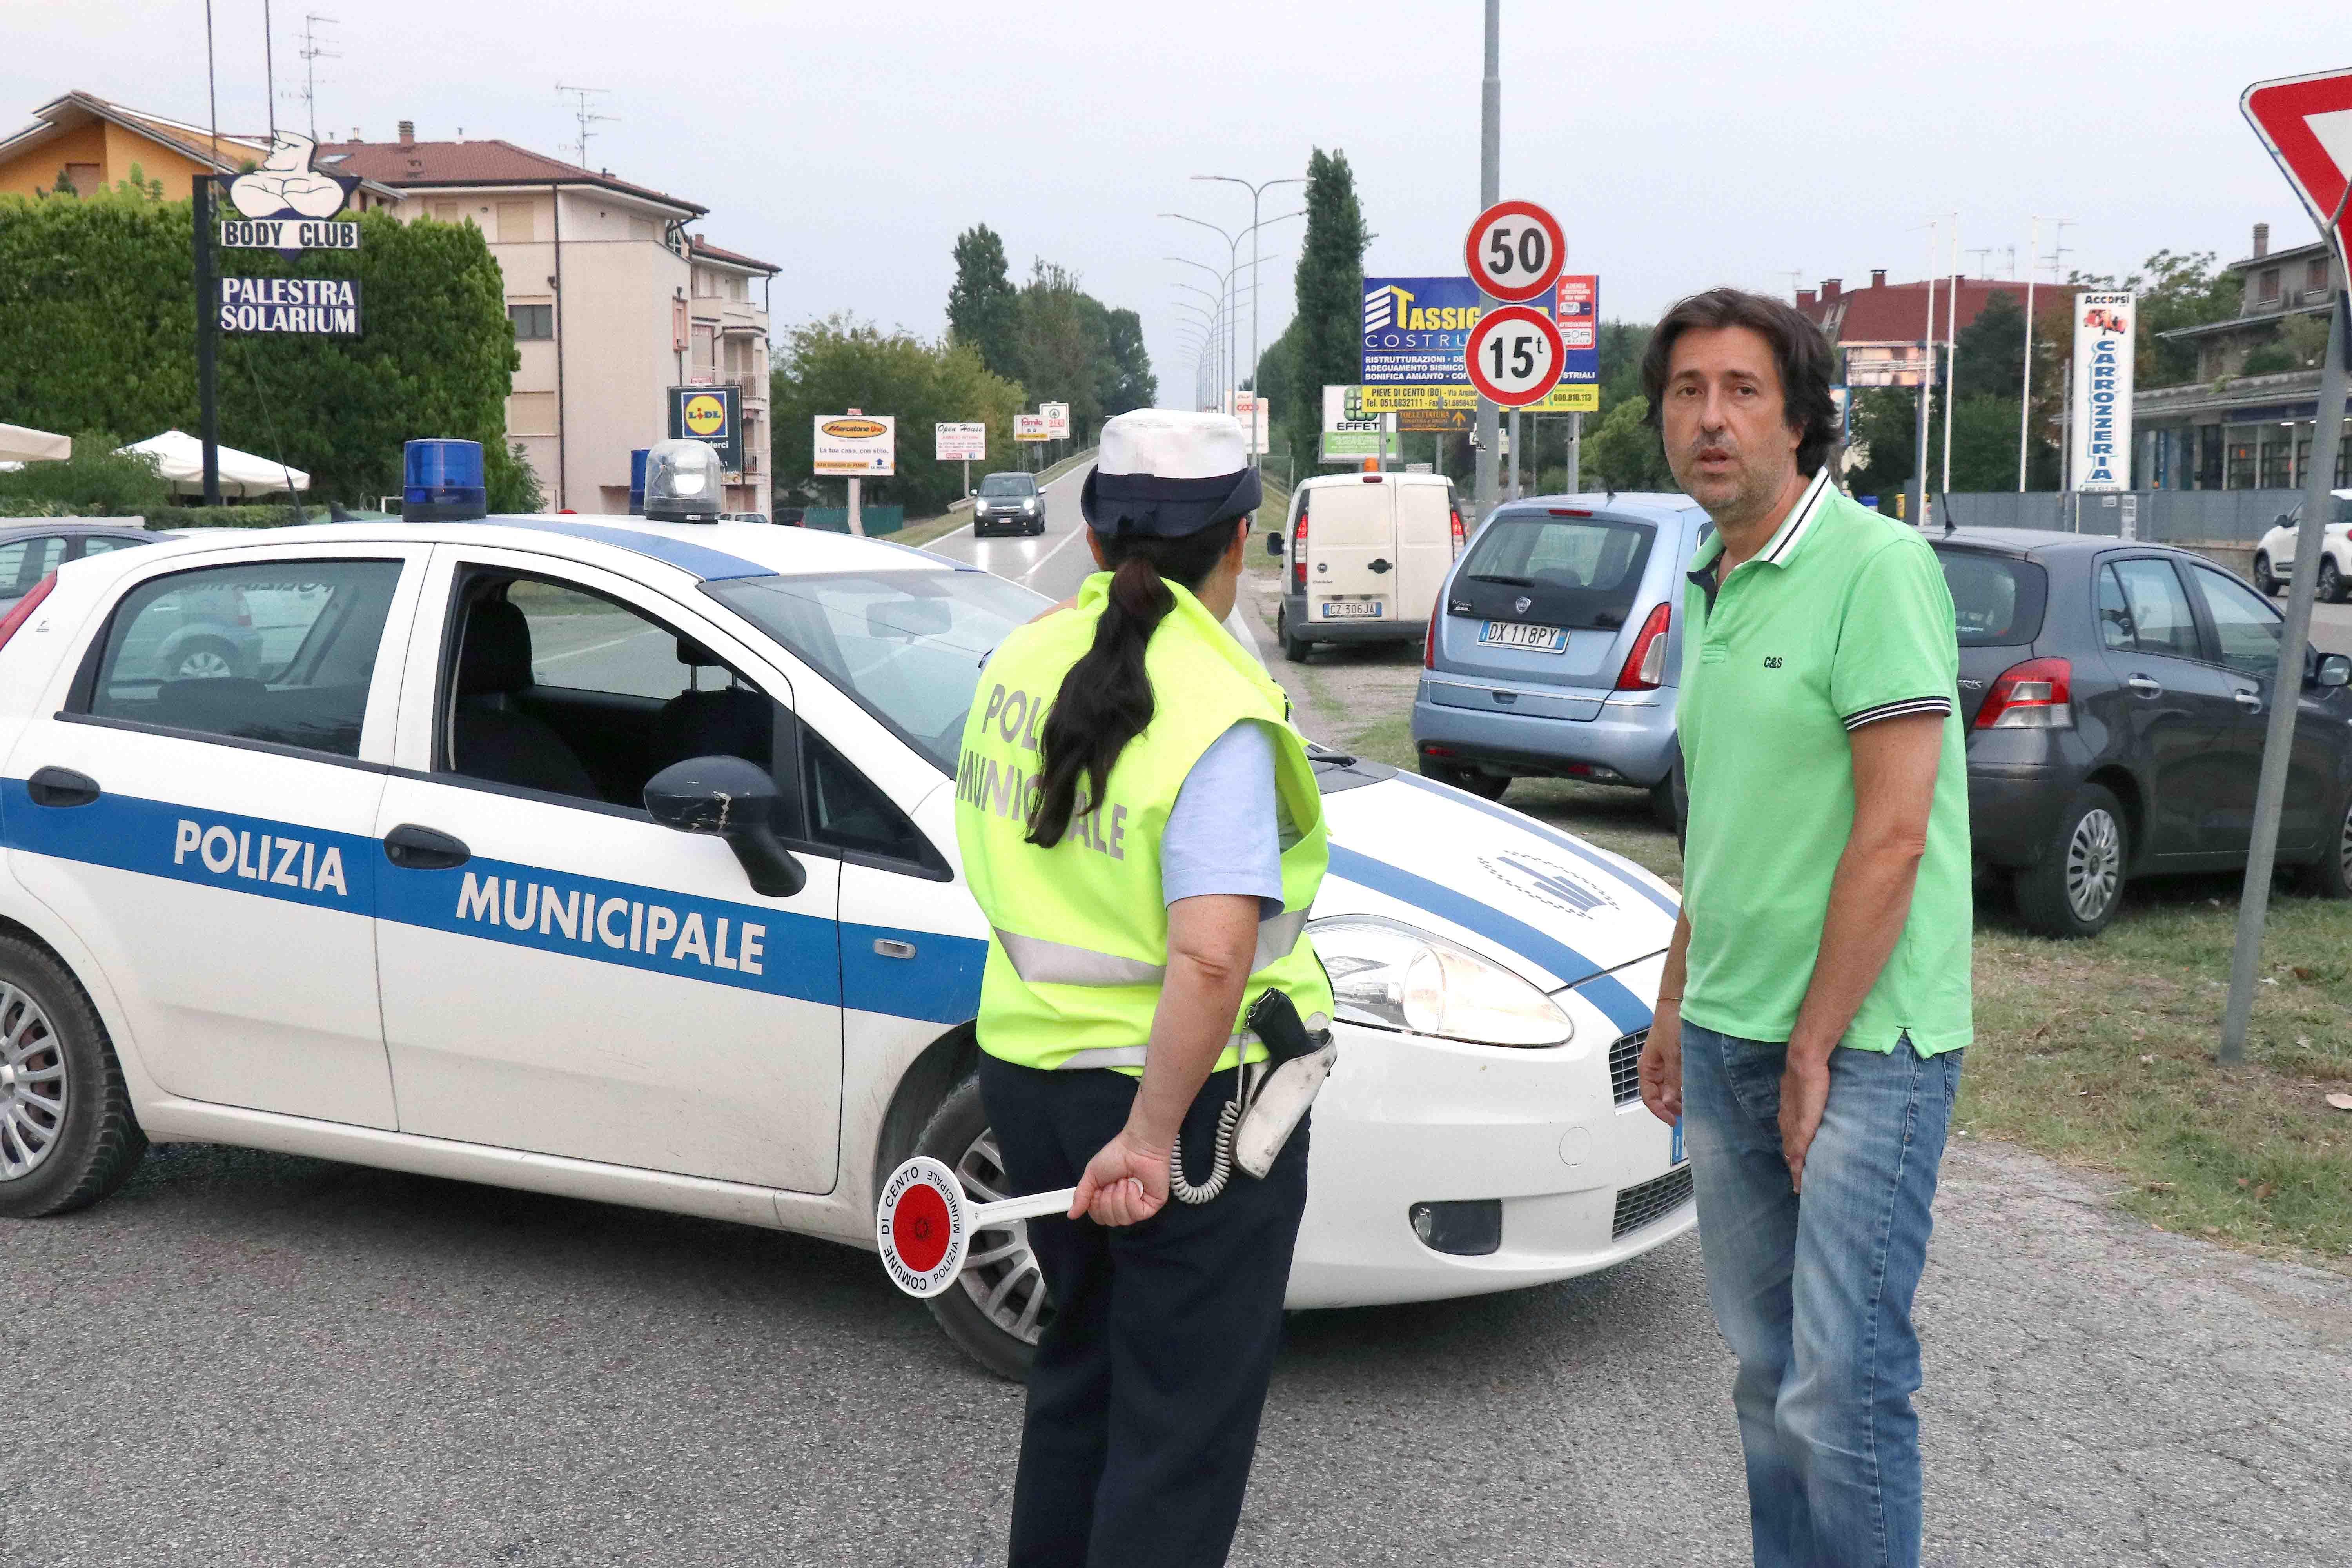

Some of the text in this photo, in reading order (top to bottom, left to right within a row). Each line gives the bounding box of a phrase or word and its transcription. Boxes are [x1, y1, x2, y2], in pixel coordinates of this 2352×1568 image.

[225, 222, 354, 247] BODY CLUB
[1489, 228, 1545, 274] 50
[222, 278, 354, 306] PALESTRA
[221, 306, 355, 333] SOLARIUM
[1365, 334, 1468, 347] COSTRU
[2091, 340, 2116, 479] CARROZZERIA
[938, 423, 983, 433] Open House
[1337, 422, 1380, 431] EFFET
[1330, 605, 1375, 614] CZ 306JA
[1488, 624, 1558, 646] DX 118PY
[955, 748, 1127, 861] MUNICALE
[174, 818, 348, 896] POLIZIA
[456, 871, 766, 976] MUNICIPALE
[881, 1167, 927, 1290] COMUNE DI CENTO
[927, 1170, 960, 1283] POLIZIA MUNICIPALE
